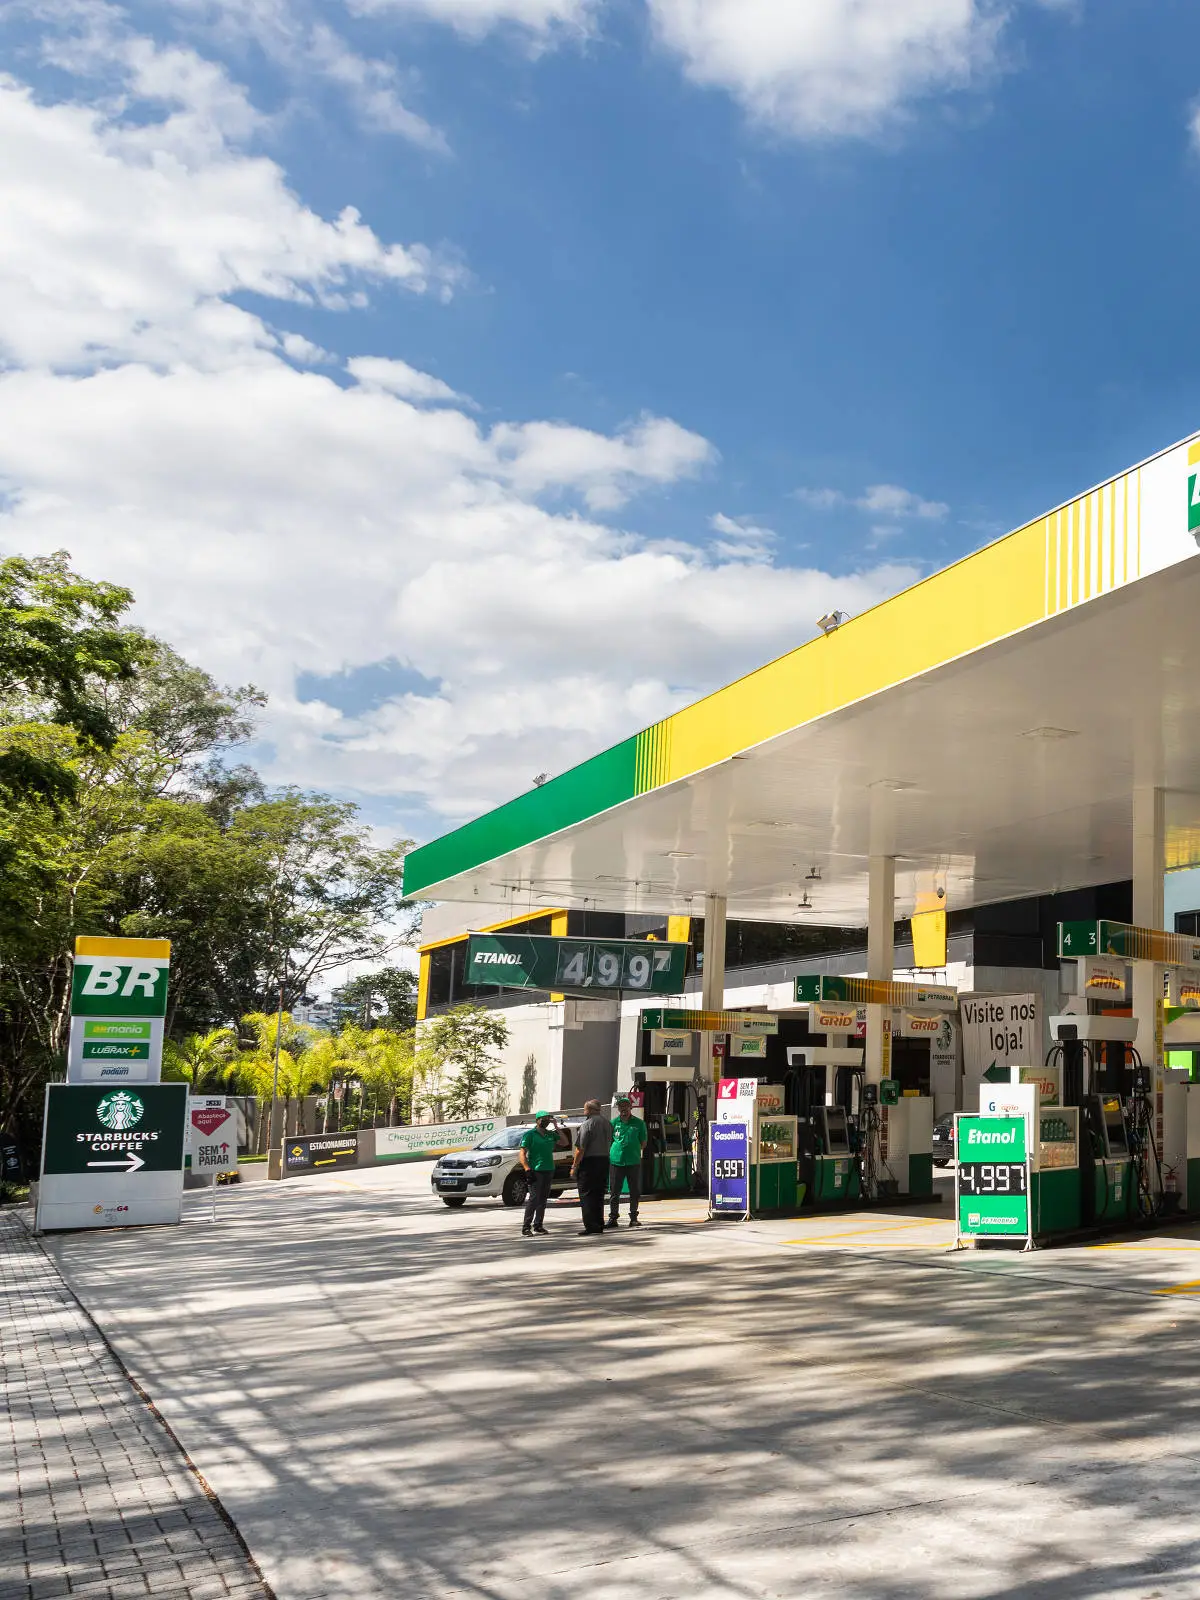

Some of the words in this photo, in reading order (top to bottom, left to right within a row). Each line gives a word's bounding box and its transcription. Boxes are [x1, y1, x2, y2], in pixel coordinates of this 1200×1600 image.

[1063, 934, 1072, 946] 4
[1088, 932, 1097, 945] 3
[474, 952, 523, 965] ETANOL
[81, 964, 160, 998] BR
[797, 985, 803, 994] 6
[814, 985, 820, 994] 5
[964, 1002, 1004, 1024] Visite
[1010, 1004, 1035, 1021] nos
[819, 1013, 853, 1027] GRID
[910, 1018, 939, 1031] GRID
[989, 1026, 1023, 1056] loja!
[740, 1082, 750, 1090] SEM
[989, 1101, 996, 1112] G
[722, 1112, 728, 1120] G
[76, 1131, 159, 1142] STARBUCKS
[388, 1132, 422, 1142] Chegou
[460, 1122, 495, 1134] POSTO
[714, 1130, 744, 1141] Gasolina
[968, 1128, 1016, 1144] Etanol
[91, 1142, 144, 1151] COFFEE
[309, 1139, 357, 1151] ESTACIONAMENTO
[407, 1141, 425, 1150] que
[425, 1138, 445, 1147] você
[446, 1134, 477, 1145] queria!
[198, 1145, 219, 1156] SEM
[198, 1154, 229, 1166] PARAR
[714, 1160, 745, 1179] 6,997
[961, 1165, 1026, 1195] 4,997
